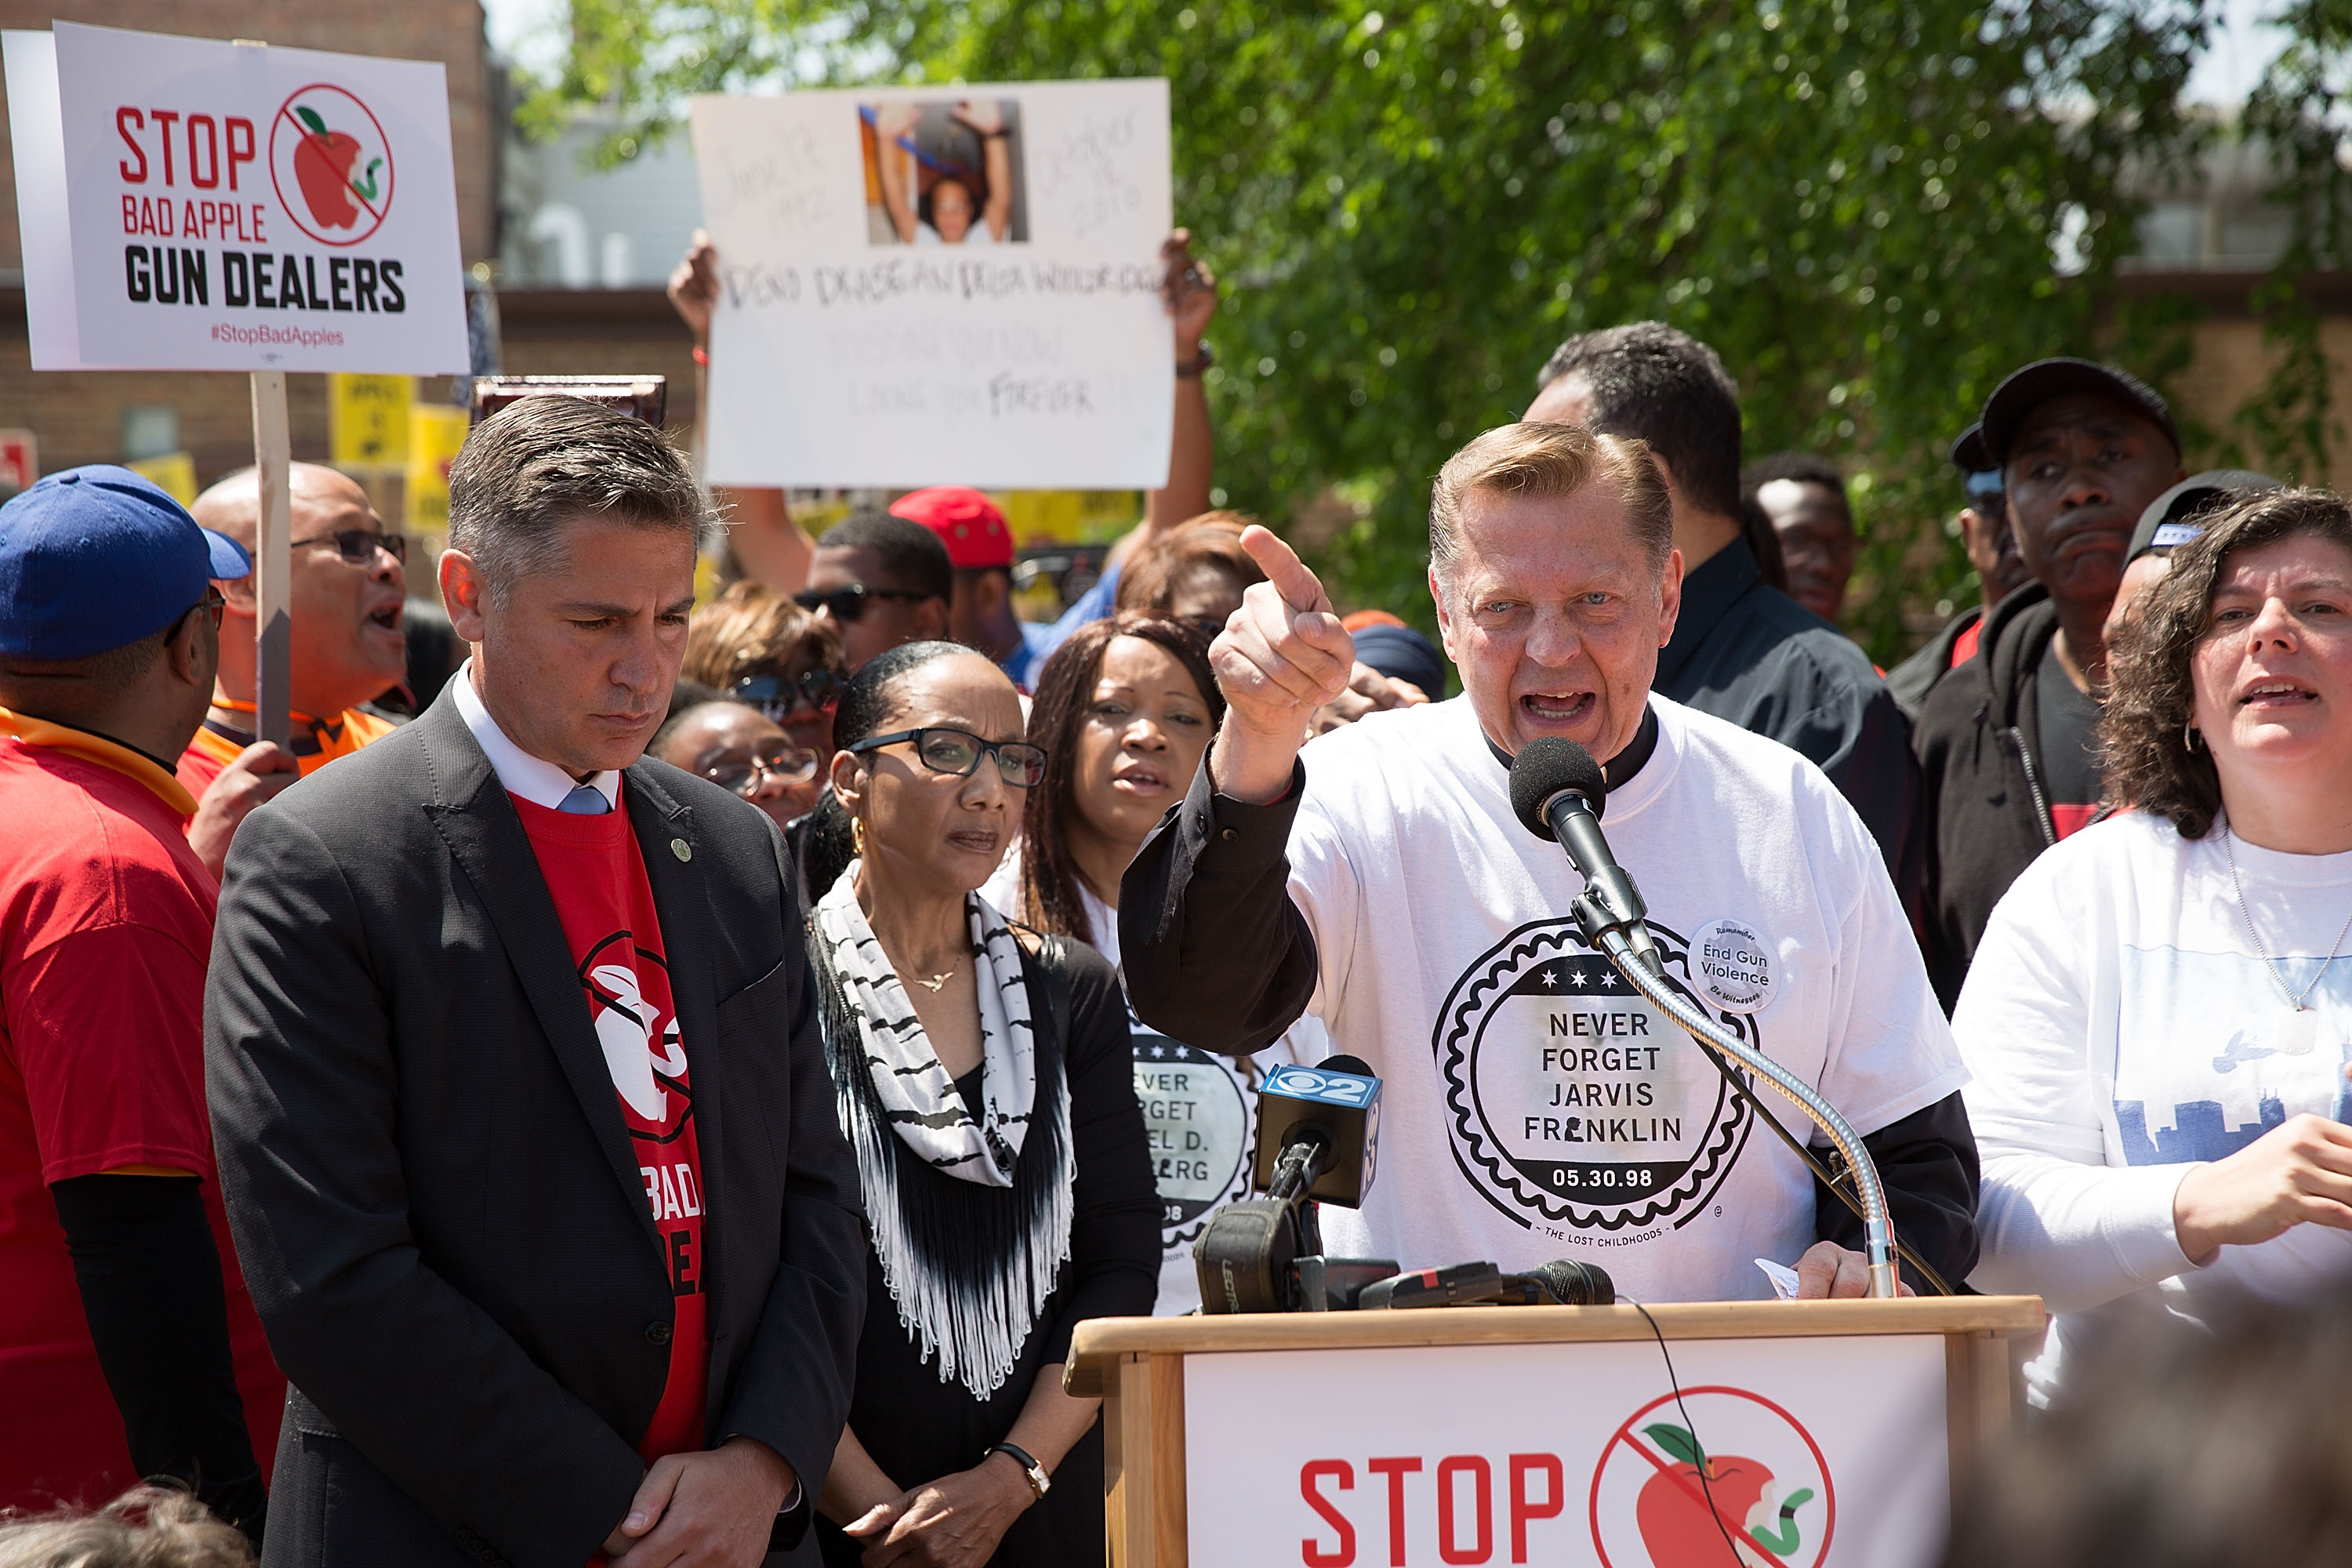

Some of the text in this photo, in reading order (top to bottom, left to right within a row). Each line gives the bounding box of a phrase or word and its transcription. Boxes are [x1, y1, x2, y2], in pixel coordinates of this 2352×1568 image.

[115, 106, 256, 192] STOP
[122, 194, 267, 244] BAD APPLE
[125, 245, 406, 314] GUN DEALERS
[210, 323, 345, 347] #StopBadApples
[1715, 927, 1756, 942] Remember
[1704, 944, 1768, 967] End Gun
[1701, 961, 1769, 986] Violence
[1710, 985, 1761, 1004] Be Witnesses
[1549, 1013, 1650, 1036] NEVER
[1542, 1047, 1661, 1071] FORGET
[1549, 1082, 1653, 1106] JARVIS
[1185, 1130, 1209, 1152] D.
[1552, 1169, 1653, 1187] 05.30.98
[1544, 1226, 1663, 1247] THE LOST CHILDHOODS
[1300, 1452, 1565, 1568] STOP
